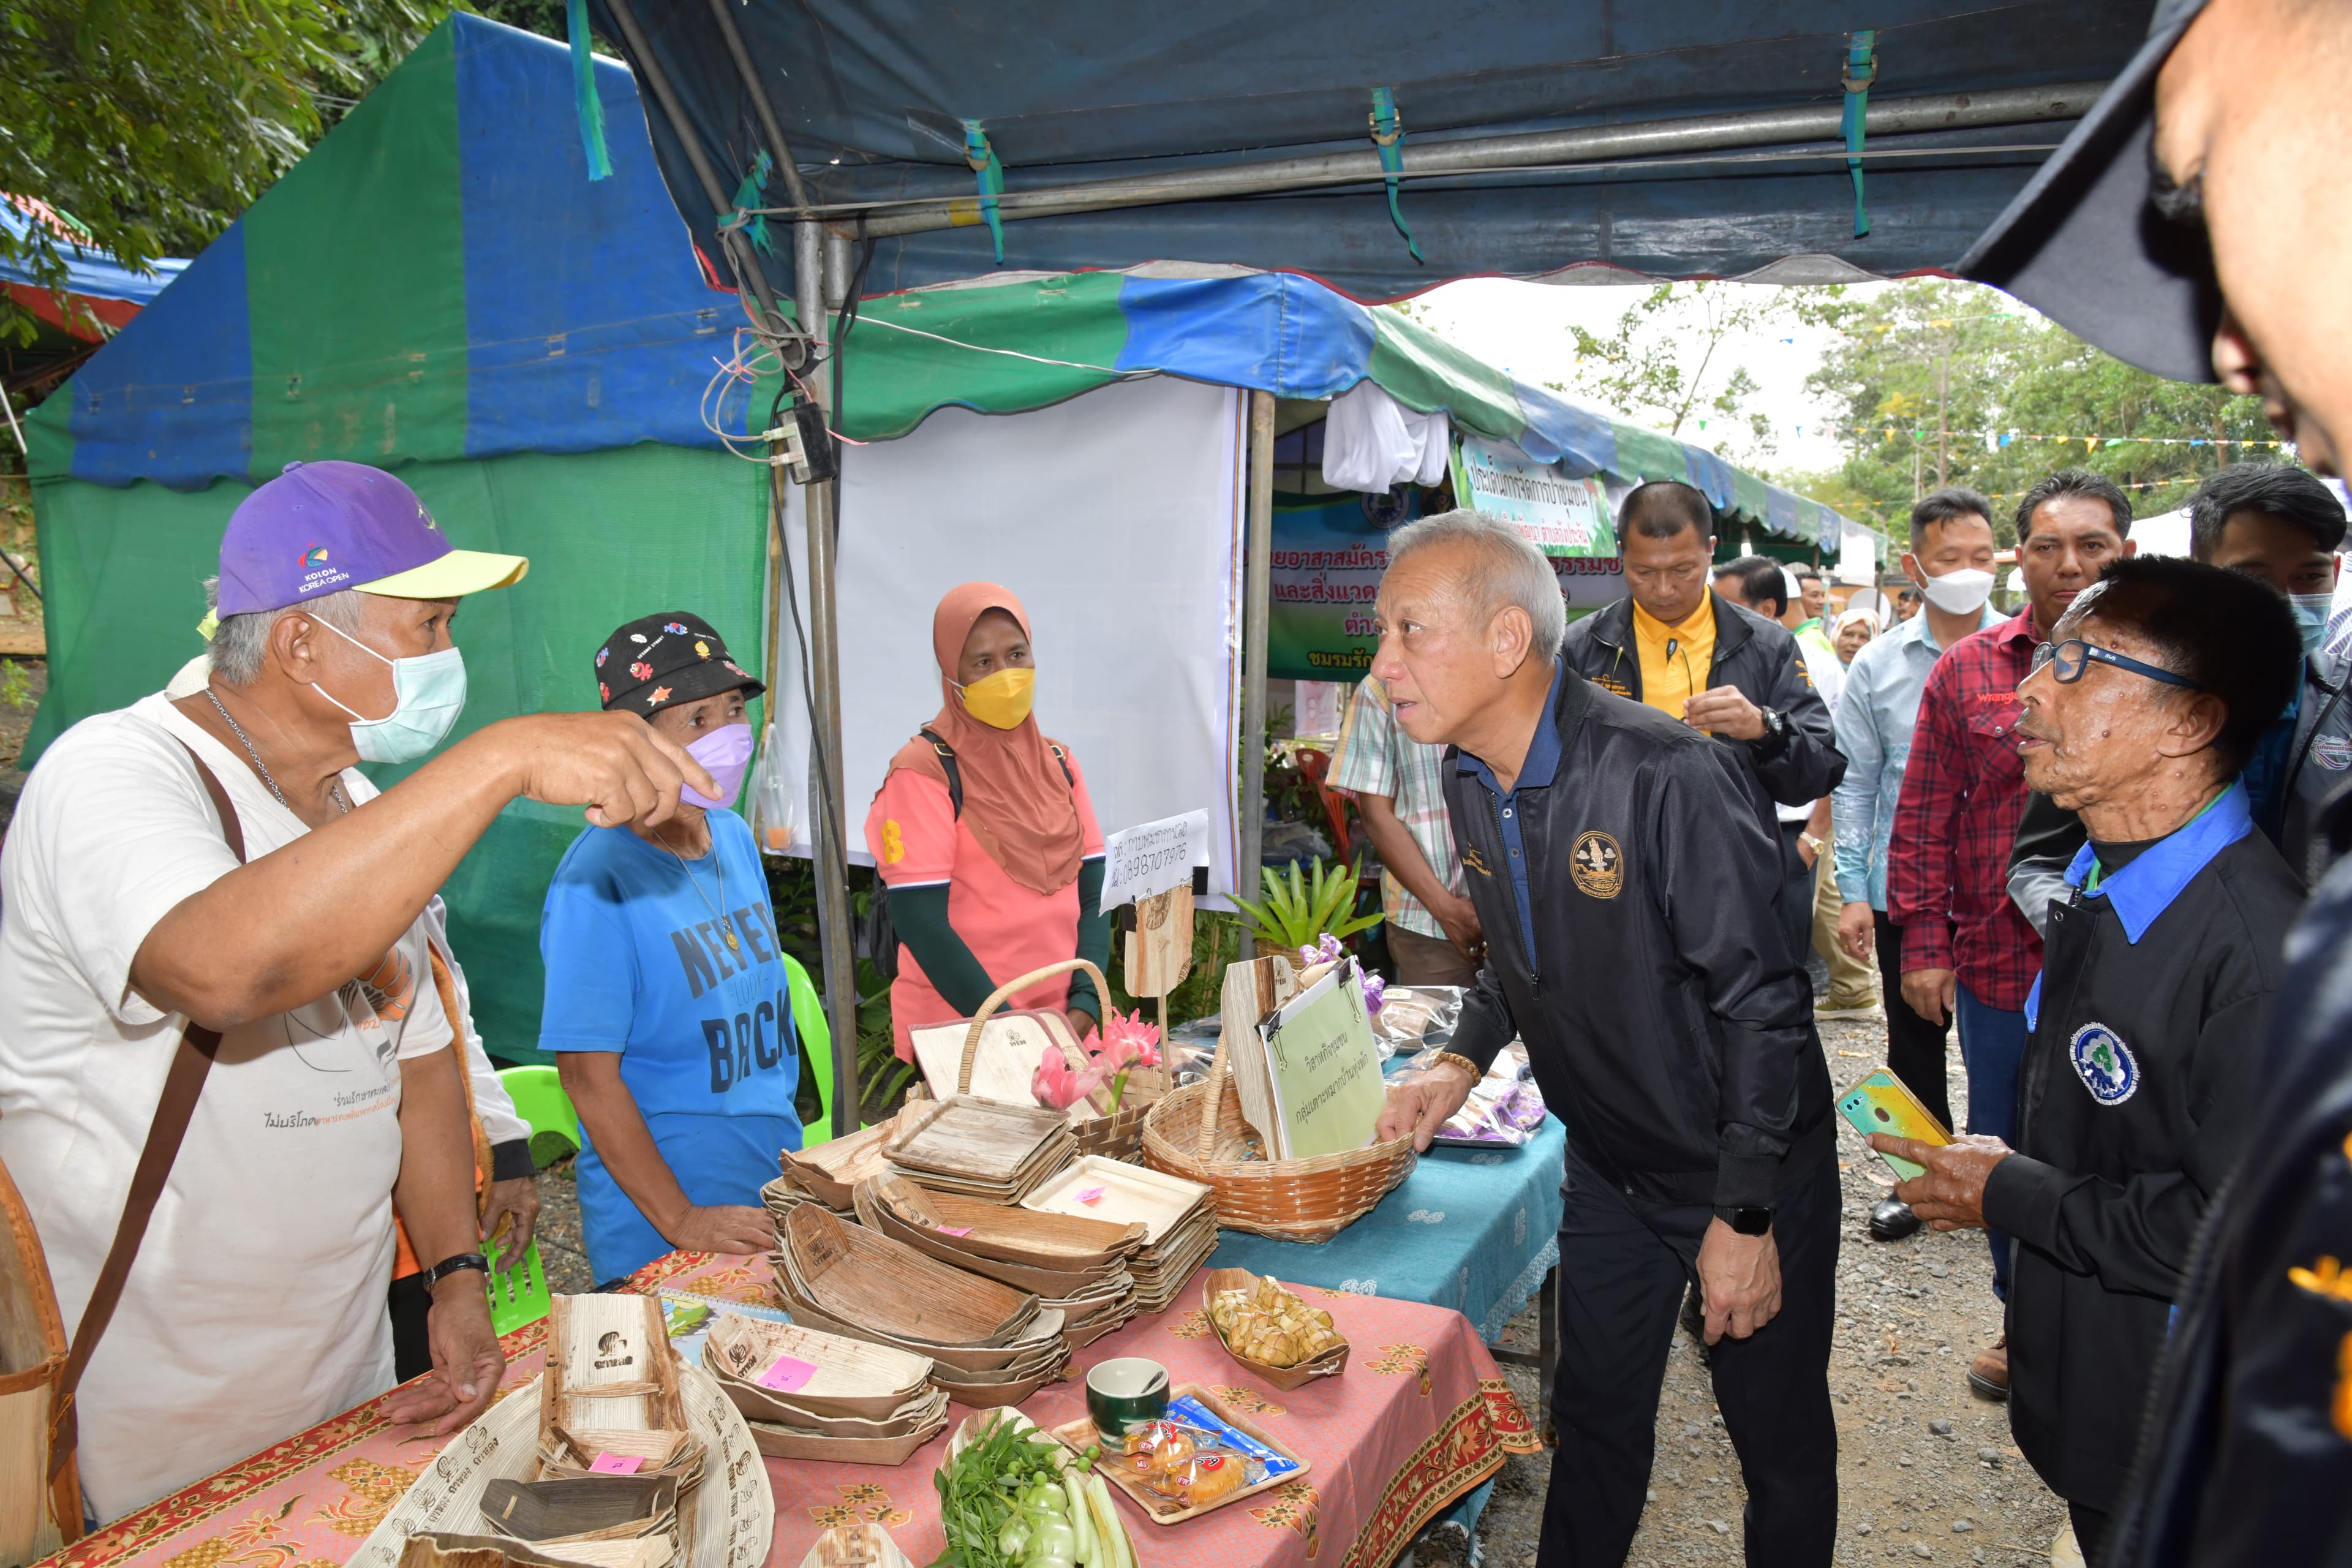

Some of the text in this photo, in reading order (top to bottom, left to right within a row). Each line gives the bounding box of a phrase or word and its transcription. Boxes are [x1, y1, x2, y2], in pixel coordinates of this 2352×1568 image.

[298, 572, 350, 594] KOREA OPEN
[304, 567, 337, 581] KOLON
[1308, 649, 1374, 667] ชมรมรัก
[671, 901, 782, 999] NEVER
[701, 984, 797, 1093] BACK
[1303, 1031, 1348, 1074] วิสาหกิจชุมชน
